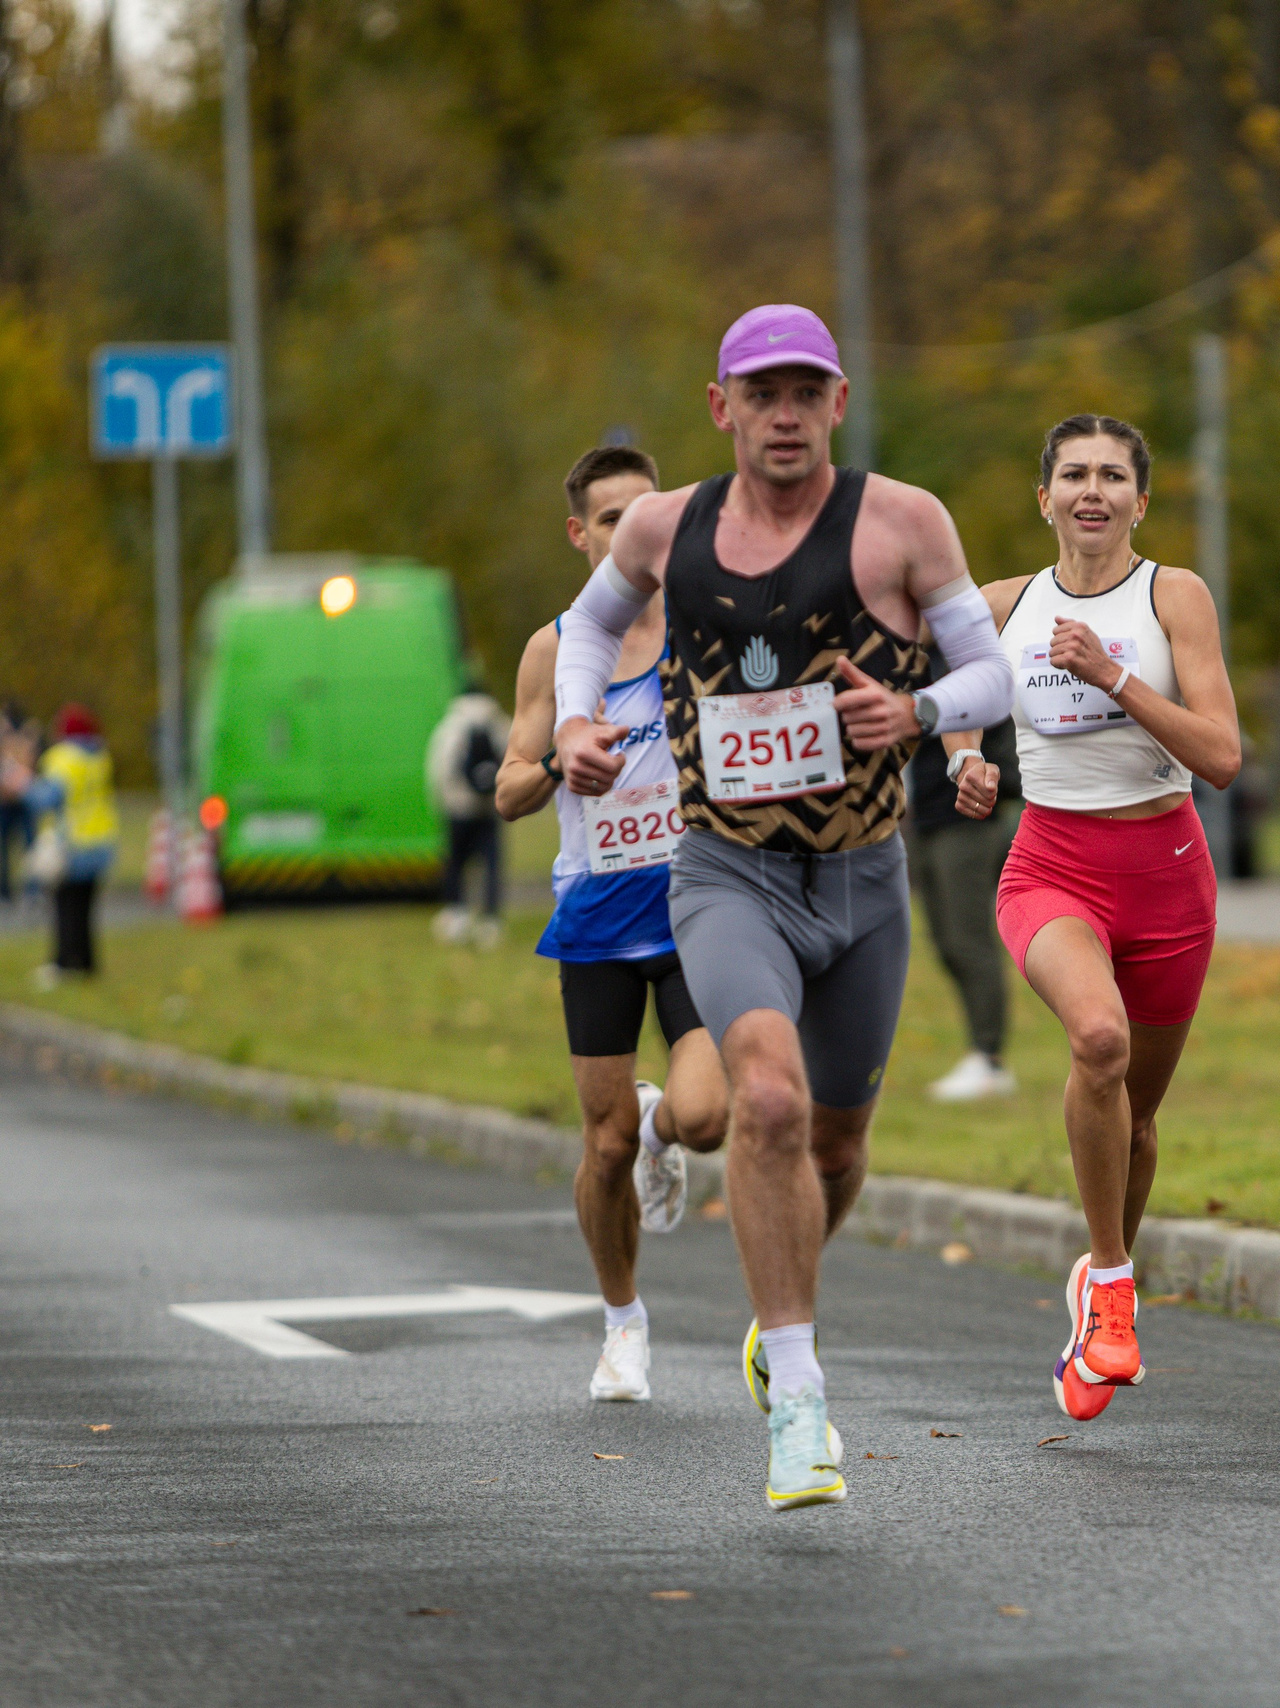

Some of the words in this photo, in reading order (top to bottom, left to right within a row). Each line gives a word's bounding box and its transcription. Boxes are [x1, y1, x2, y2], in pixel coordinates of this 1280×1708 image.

[1027, 673, 1086, 688] АПЛАЧ
[1071, 693, 1085, 703] 17
[606, 720, 663, 752] SIS
[720, 721, 823, 768] 2512
[596, 805, 687, 849] 2820
